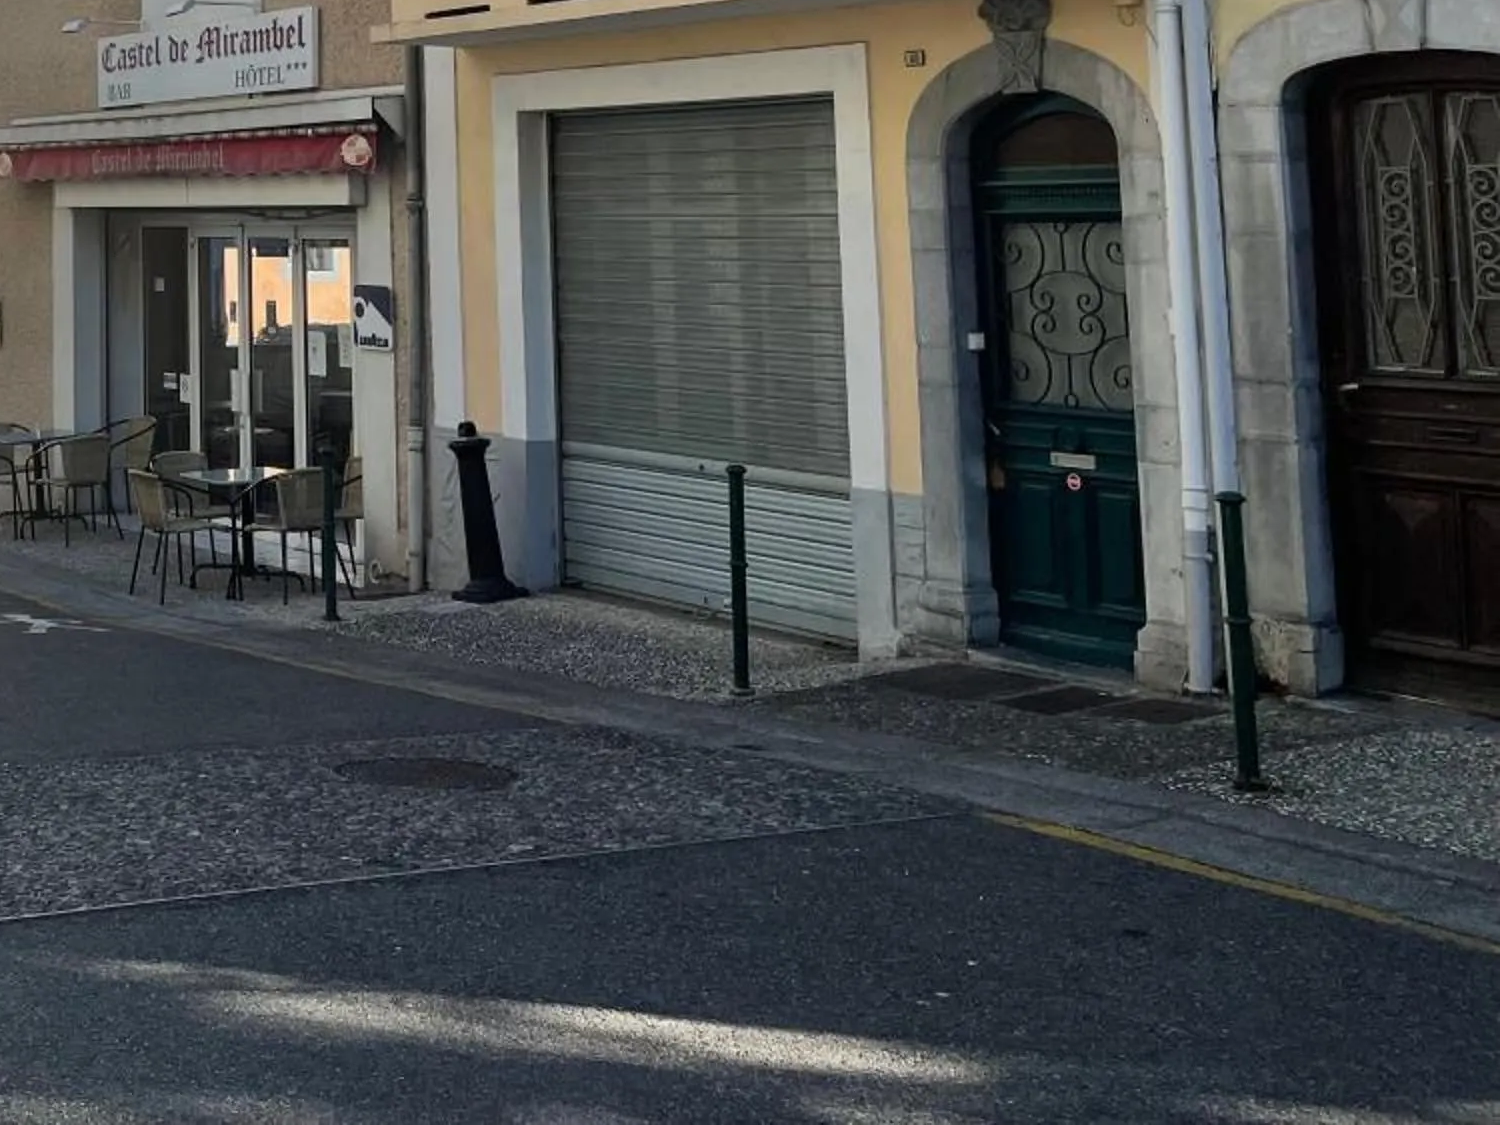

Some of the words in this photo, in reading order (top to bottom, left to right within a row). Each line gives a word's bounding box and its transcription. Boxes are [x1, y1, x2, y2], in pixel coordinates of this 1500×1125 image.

[101, 35, 162, 73] Castel
[167, 34, 189, 63] de
[195, 13, 307, 64] Mirambel
[107, 82, 132, 101] BAR
